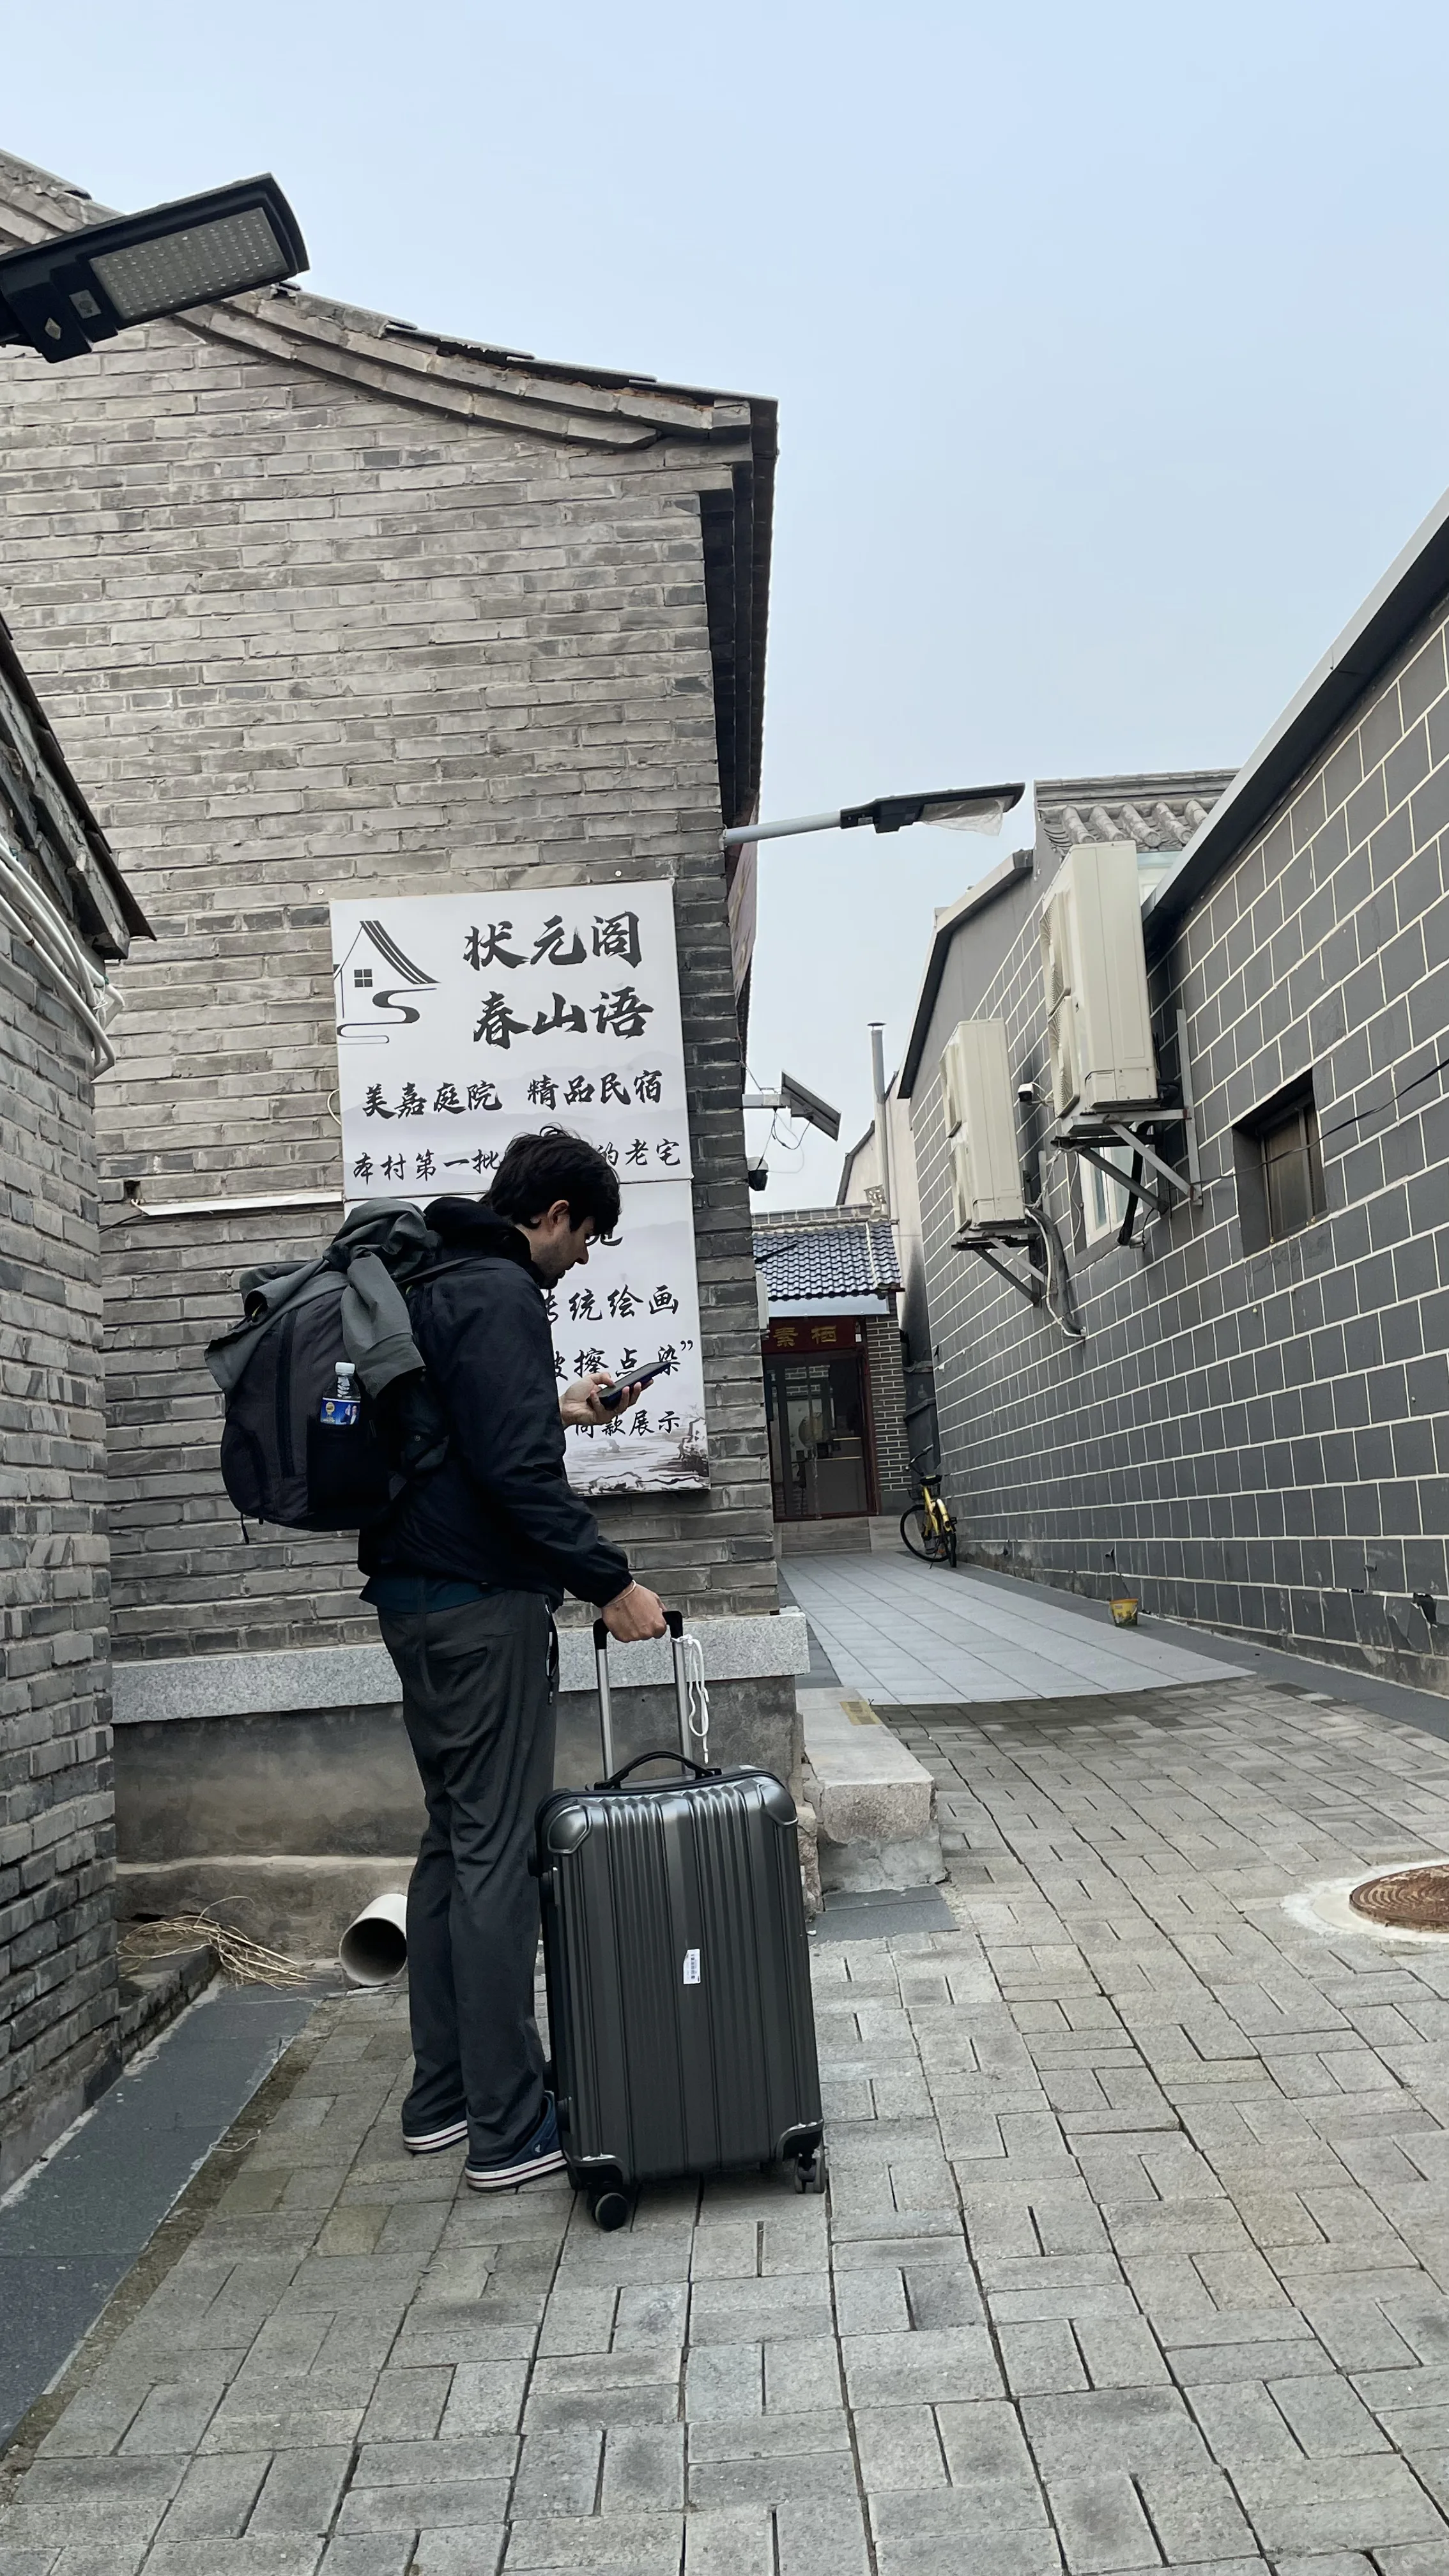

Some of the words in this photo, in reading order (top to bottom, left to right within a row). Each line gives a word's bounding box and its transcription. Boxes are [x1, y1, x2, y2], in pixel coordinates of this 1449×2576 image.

[463, 911, 643, 971] 状元阁
[473, 986, 655, 1050] 春山语
[362, 1080, 503, 1119] 美嘉庭院
[527, 1070, 663, 1110] 精品民宿
